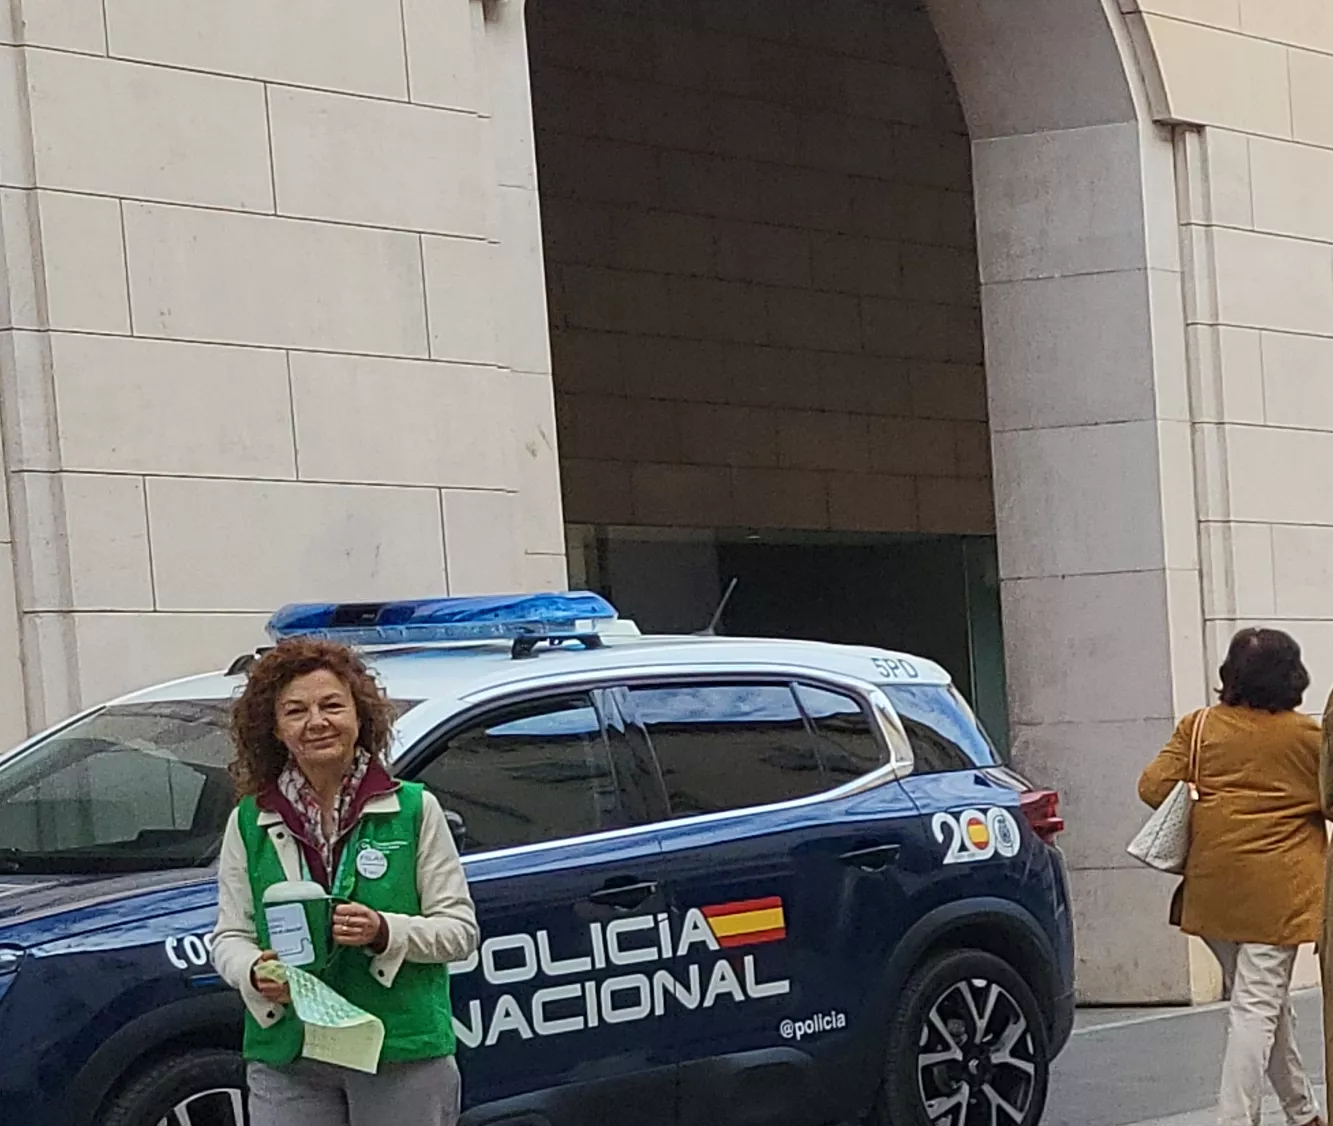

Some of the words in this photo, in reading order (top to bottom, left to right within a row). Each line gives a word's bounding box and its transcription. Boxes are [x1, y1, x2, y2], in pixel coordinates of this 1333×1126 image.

[870, 657, 919, 678] 5PD
[931, 806, 1020, 865] 200
[779, 1010, 846, 1041] @policia
